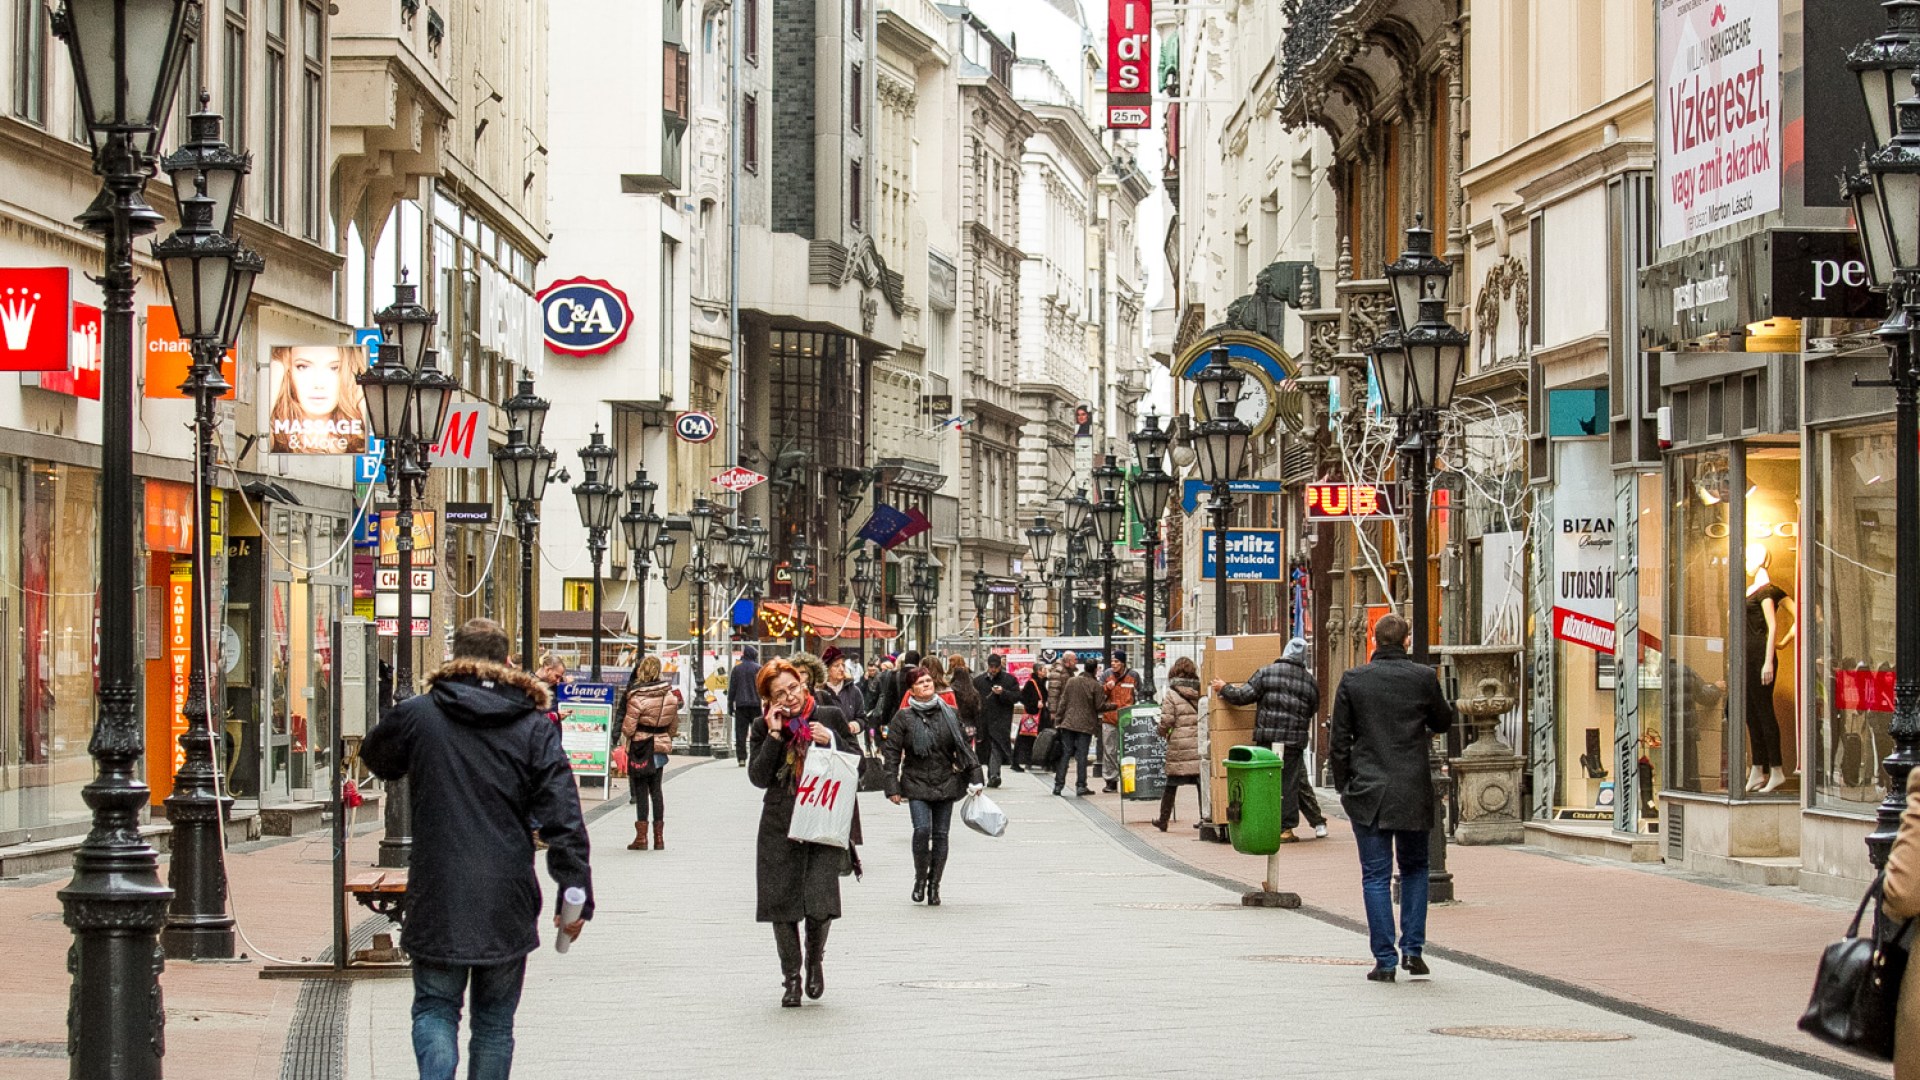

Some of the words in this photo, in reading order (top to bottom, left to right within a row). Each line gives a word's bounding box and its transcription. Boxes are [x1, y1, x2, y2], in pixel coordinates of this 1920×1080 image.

[1709, 17, 1751, 63] SHAKESPEARE
[1113, 111, 1129, 122] 25
[1130, 113, 1141, 122] m
[1669, 48, 1770, 155] Vízkereszt,
[1671, 167, 1696, 210] vagy
[1699, 147, 1723, 195] amit
[1726, 127, 1771, 184] akartok
[1708, 201, 1731, 222] Marton
[1731, 190, 1753, 216] László
[1811, 260, 1871, 301] pe
[547, 297, 617, 334] C&A
[149, 337, 195, 361] chan
[274, 419, 362, 434] MASSAGE
[304, 436, 349, 450] More
[430, 410, 479, 460] &M
[680, 418, 709, 435] C&A
[446, 511, 488, 519] promod
[1207, 553, 1275, 564] Nelviskola
[1233, 570, 1263, 579] emelet
[382, 572, 428, 587] CHGE
[1562, 565, 1602, 599] UTOLSÓ
[174, 585, 185, 645] CAMBIO
[174, 654, 186, 723] WECHSEL
[563, 684, 609, 698] Change
[797, 774, 842, 812] H&M
[1621, 740, 1632, 829] VÉGKIÁRUSÍ
